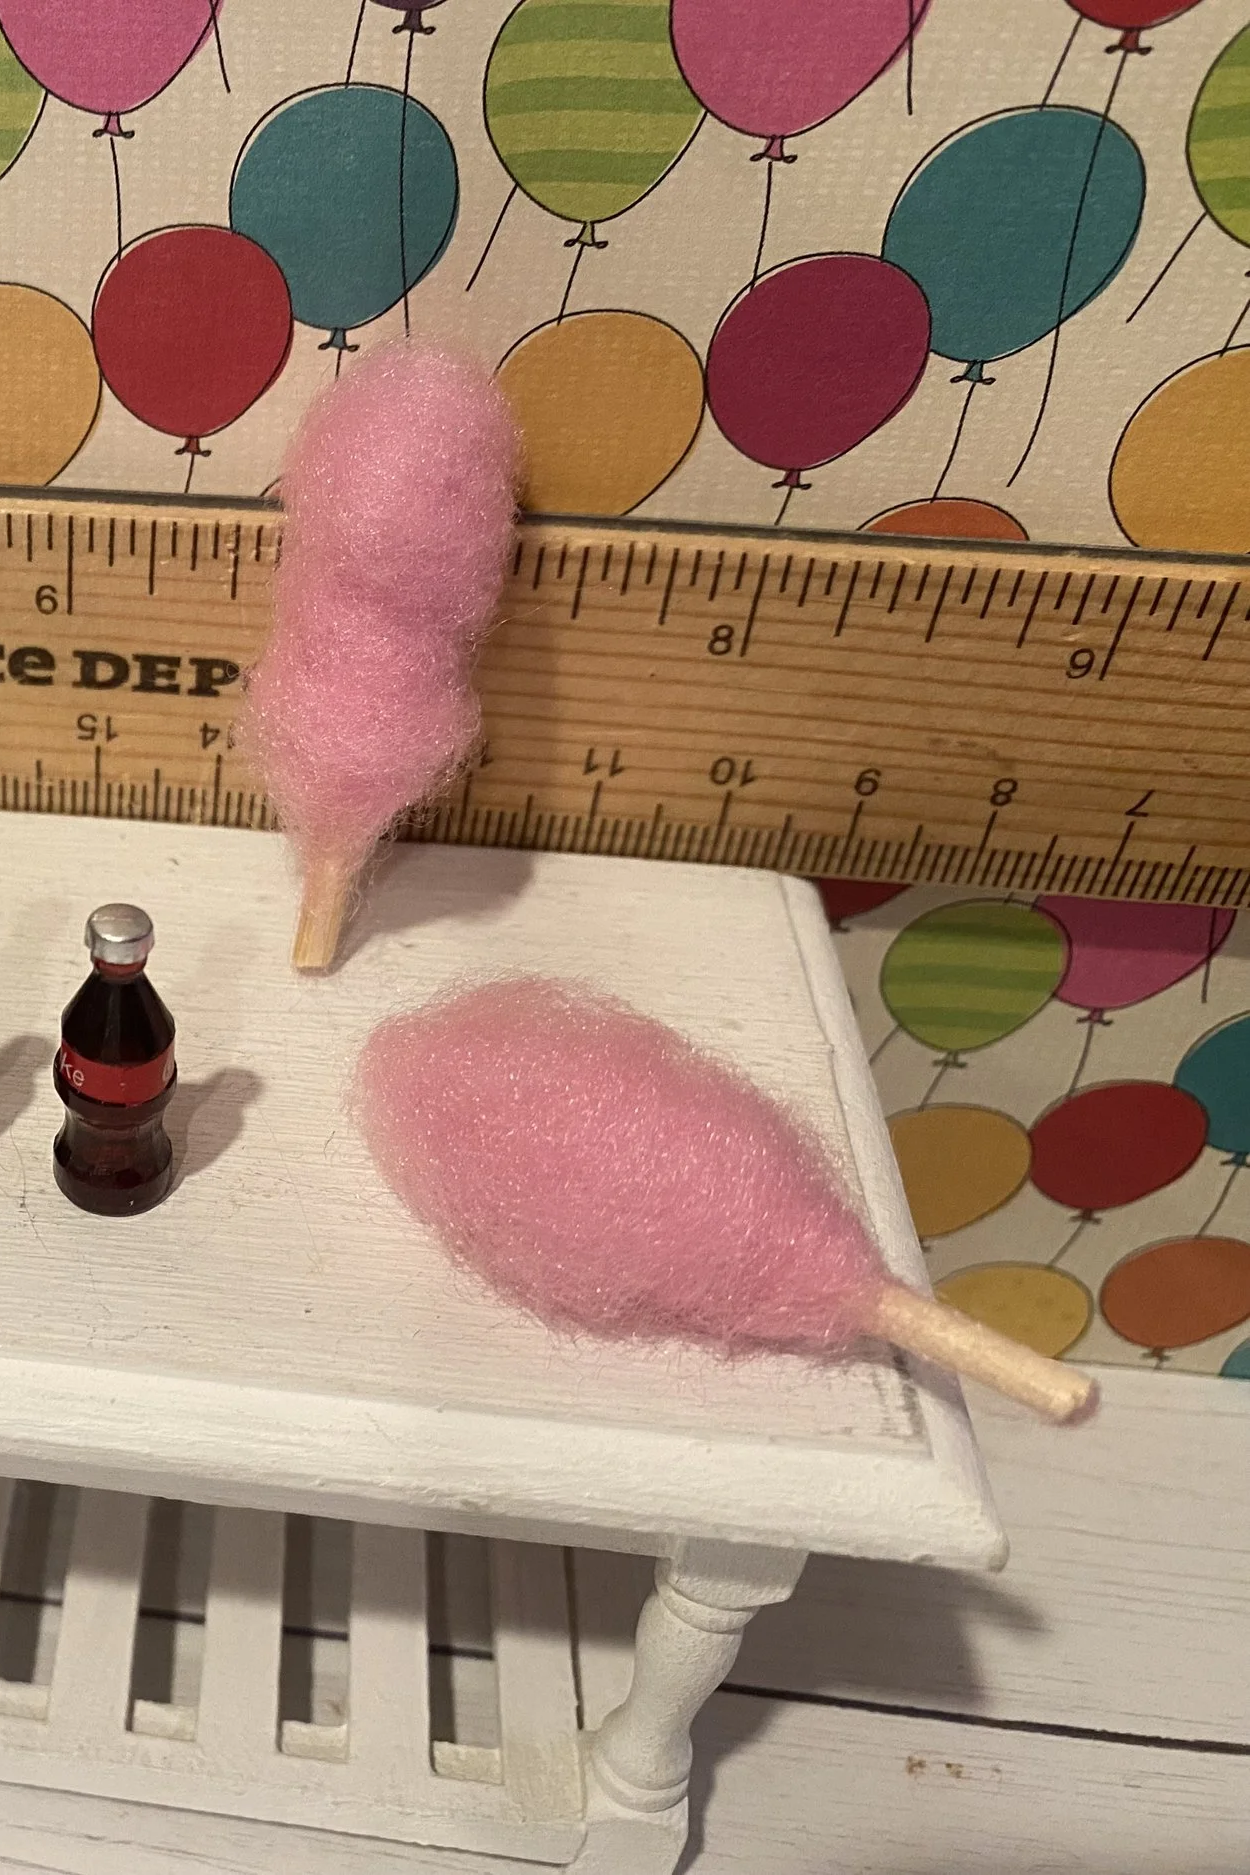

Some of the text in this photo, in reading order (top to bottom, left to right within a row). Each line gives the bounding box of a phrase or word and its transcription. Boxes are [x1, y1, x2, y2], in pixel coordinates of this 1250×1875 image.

[35, 584, 58, 615] 6
[707, 624, 734, 656] 8
[72, 649, 240, 698] DEP
[1066, 647, 1095, 679] 9
[77, 713, 118, 743] 15
[583, 747, 626, 778] 11
[710, 755, 759, 788] 10
[989, 777, 1019, 807] 8
[1125, 788, 1155, 818] 7
[59, 1051, 85, 1087] ke
